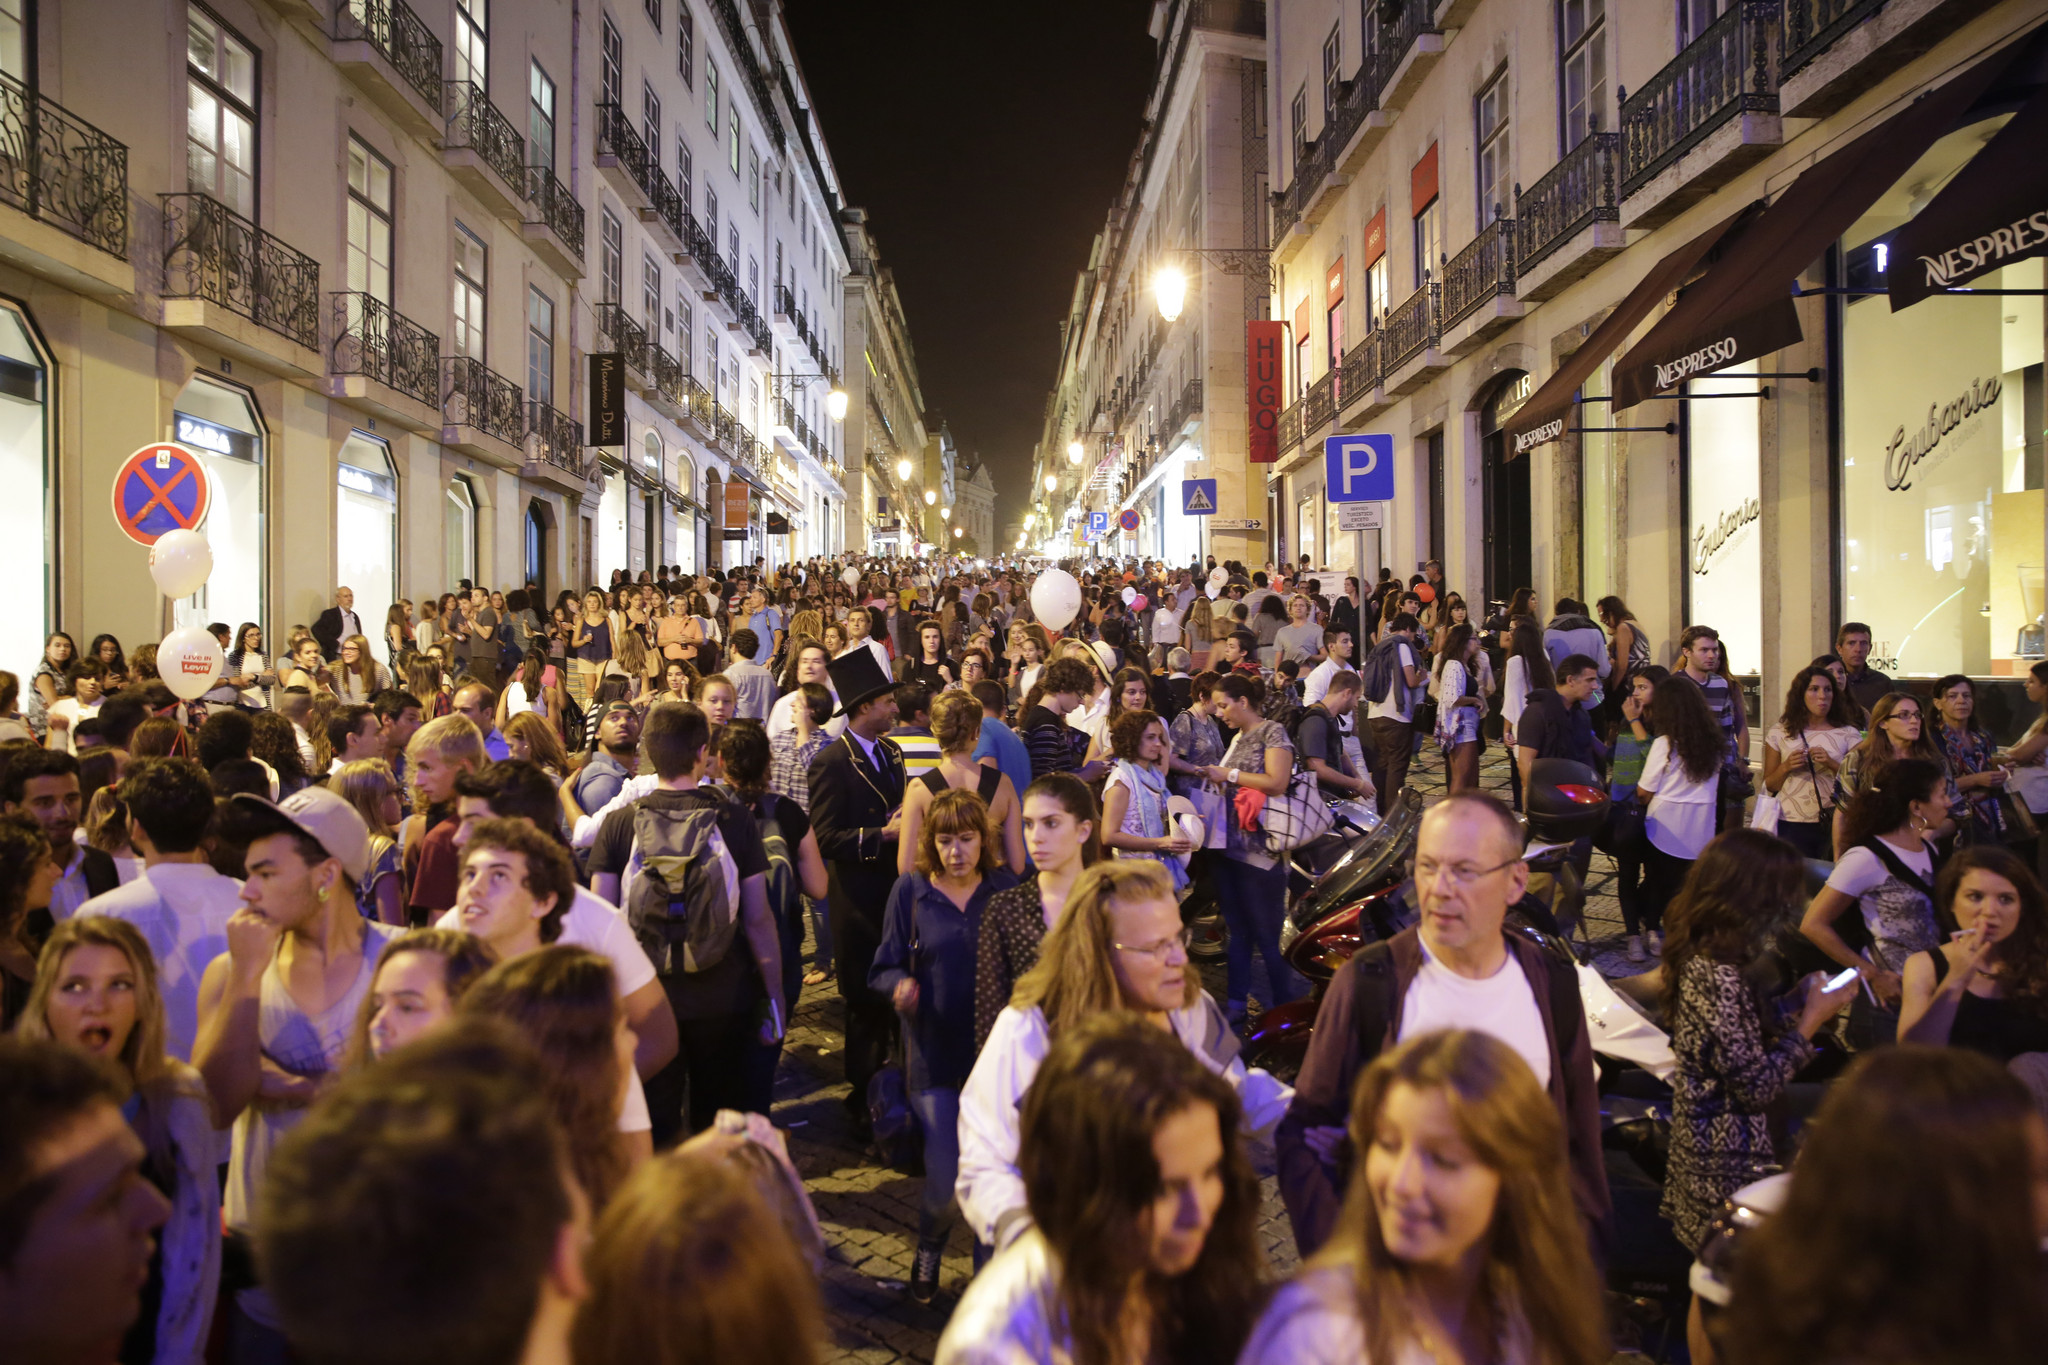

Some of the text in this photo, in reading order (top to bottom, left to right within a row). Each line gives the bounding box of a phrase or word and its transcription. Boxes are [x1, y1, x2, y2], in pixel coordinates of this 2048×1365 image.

[1916, 211, 2048, 287] NESPRES
[1256, 338, 1277, 431] HUGO
[1653, 337, 1737, 388] NESPRESSO
[179, 420, 232, 455] ZARA
[601, 411, 615, 441] Dutti
[1514, 419, 1563, 453] NESPRESSO
[1884, 375, 2002, 491] Cubania
[1342, 443, 1377, 494] P
[1093, 514, 1104, 528] P
[1692, 497, 1760, 576] Cubania
